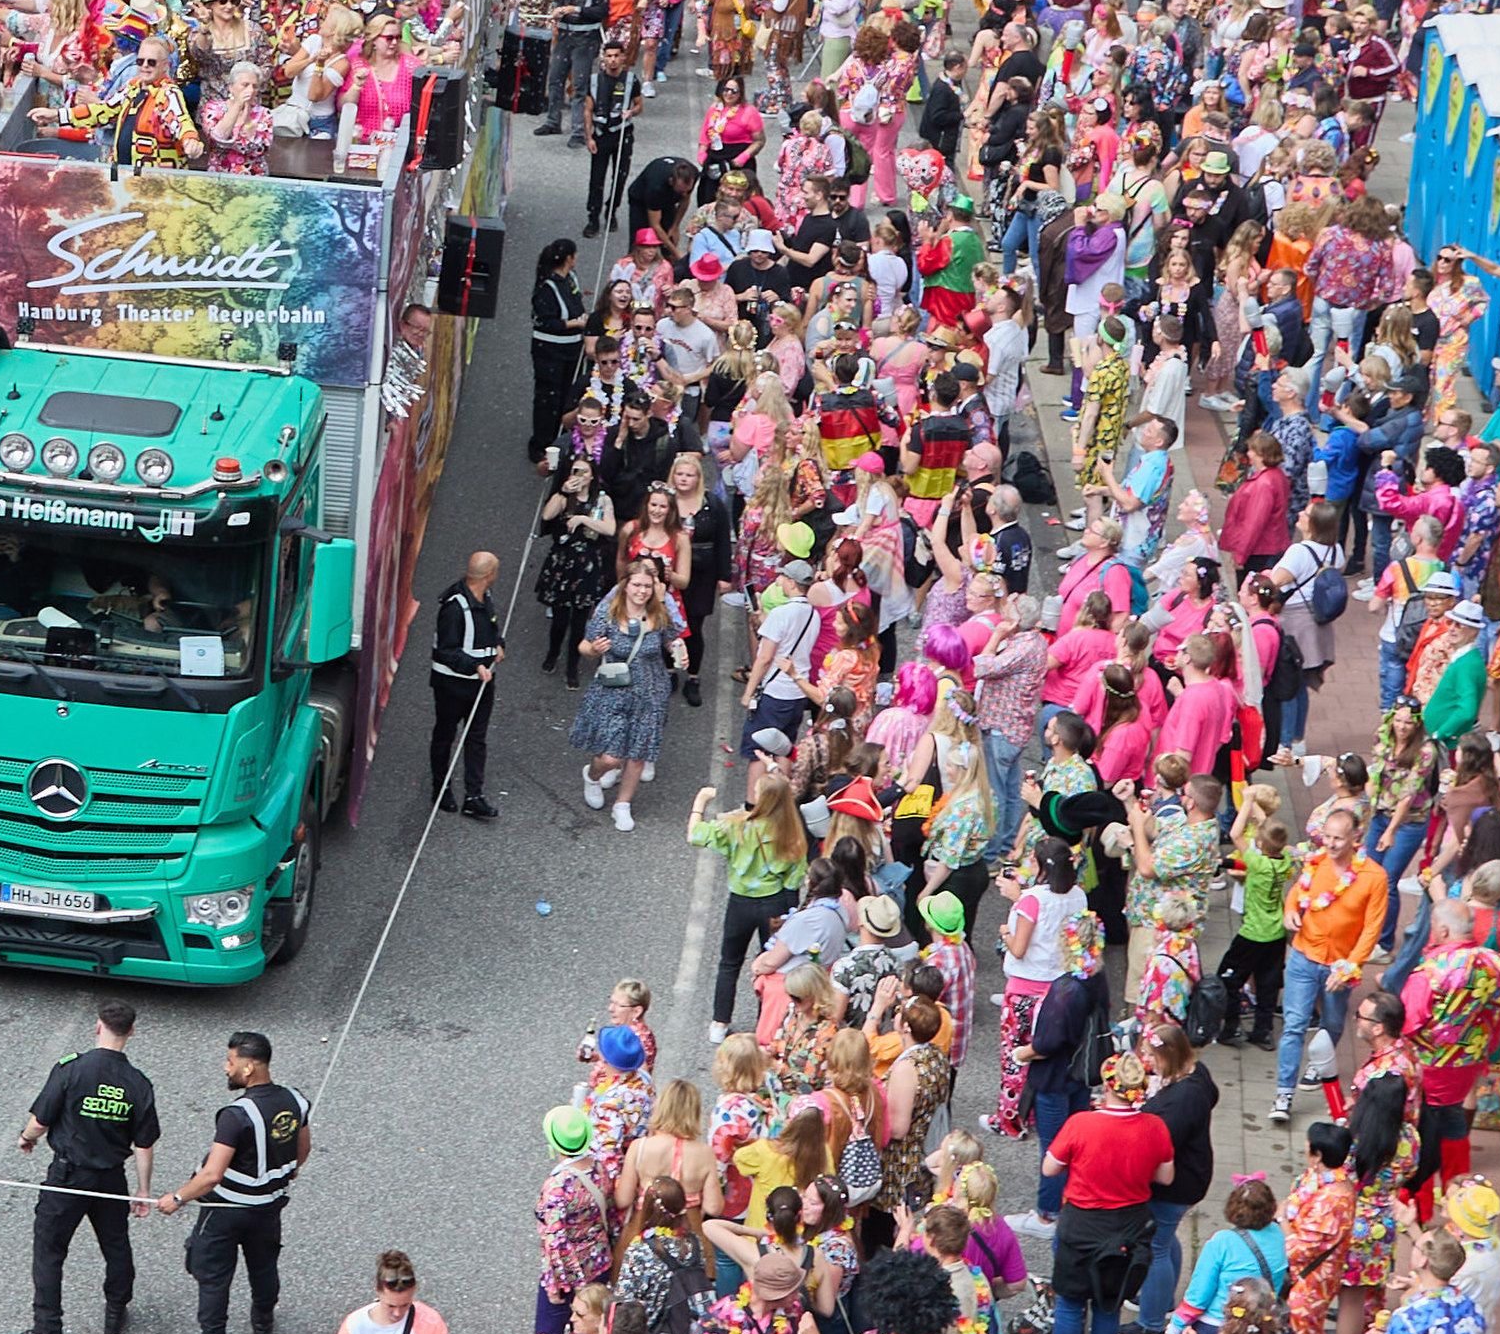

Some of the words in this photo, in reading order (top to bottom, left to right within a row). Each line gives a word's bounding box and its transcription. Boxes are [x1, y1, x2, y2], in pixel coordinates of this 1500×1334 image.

[26, 211, 298, 289] Schmidt
[17, 301, 102, 327] Hamburg
[116, 303, 194, 324] Theater
[207, 304, 326, 329] Reeperbahn
[12, 495, 135, 530] Heißmann
[11, 886, 32, 904] HH
[41, 890, 62, 907] JH
[64, 893, 92, 910] 656
[97, 1083, 125, 1100] GSS
[82, 1096, 135, 1115] SECURITY
